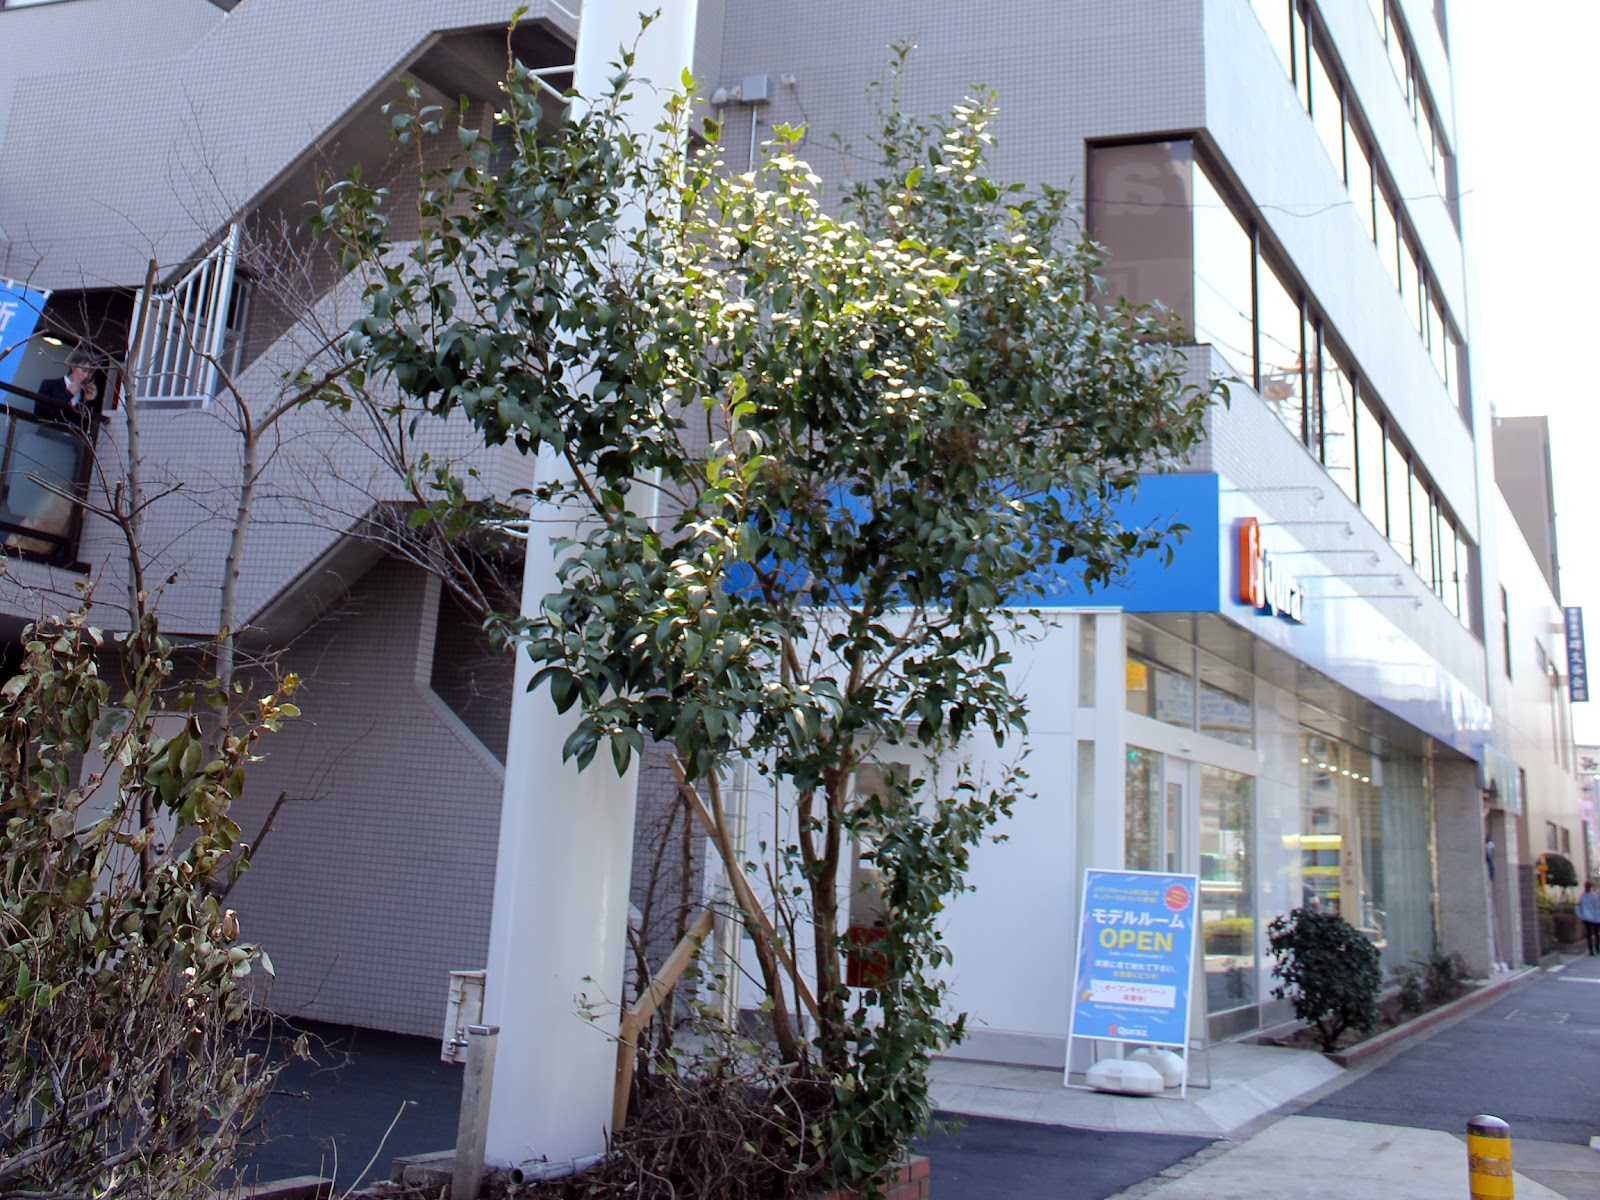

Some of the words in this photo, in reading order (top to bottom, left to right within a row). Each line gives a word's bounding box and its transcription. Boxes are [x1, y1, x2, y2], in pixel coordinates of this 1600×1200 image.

[1091, 908, 1185, 929] モデルルーム
[1099, 927, 1174, 953] OPEN
